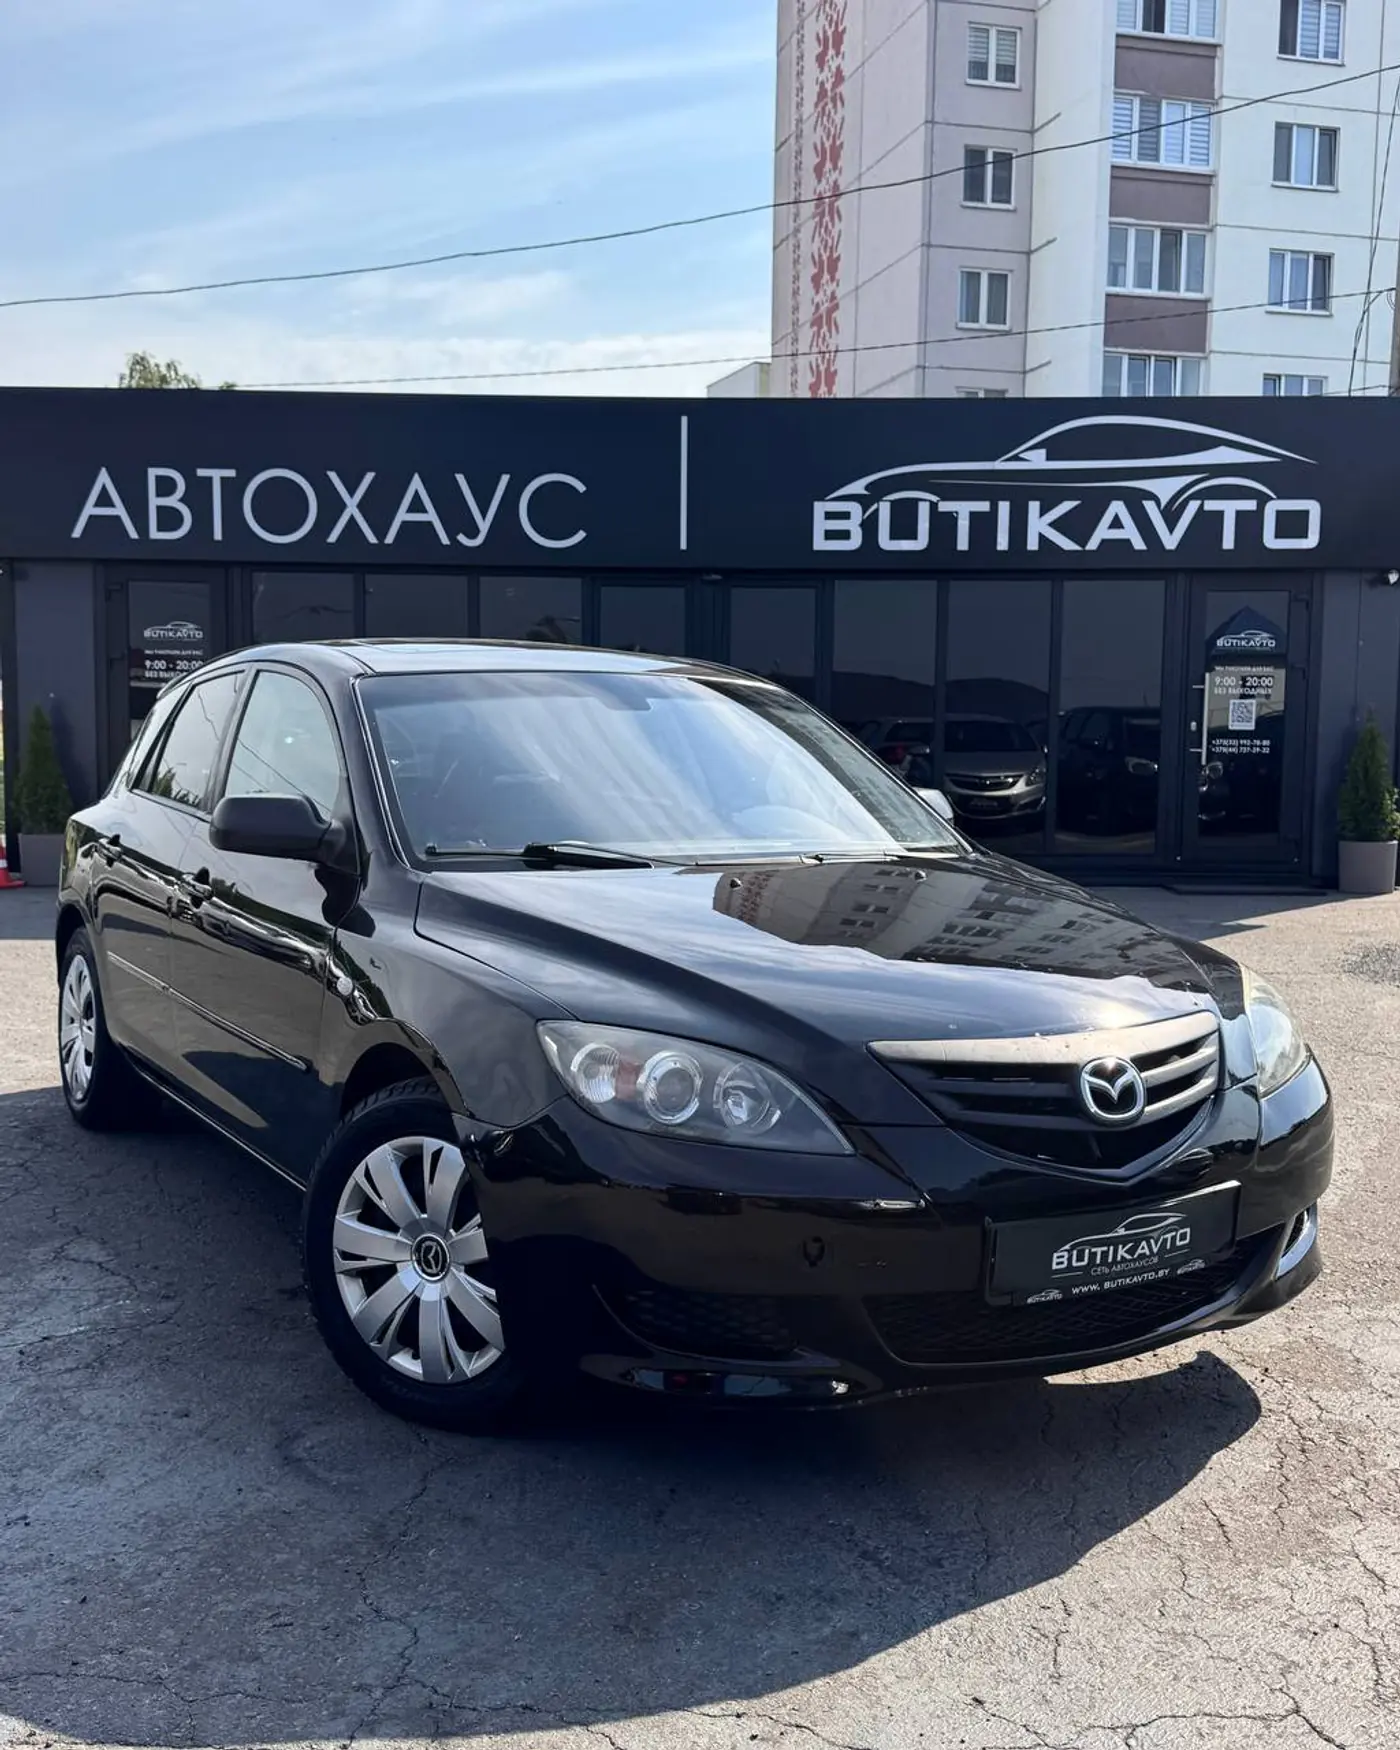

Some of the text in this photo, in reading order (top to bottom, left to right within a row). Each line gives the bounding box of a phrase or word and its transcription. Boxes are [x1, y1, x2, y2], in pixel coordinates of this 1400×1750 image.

[71, 466, 588, 549] АВТОХАУС
[812, 498, 1322, 552] BUTIKAVTO
[1216, 639, 1276, 648] BUTIKAVTO
[145, 660, 167, 670] 9:00
[1214, 677, 1236, 686] 9:00
[1246, 677, 1273, 686] 20:00
[1051, 1227, 1191, 1270] BUTIKAVTO
